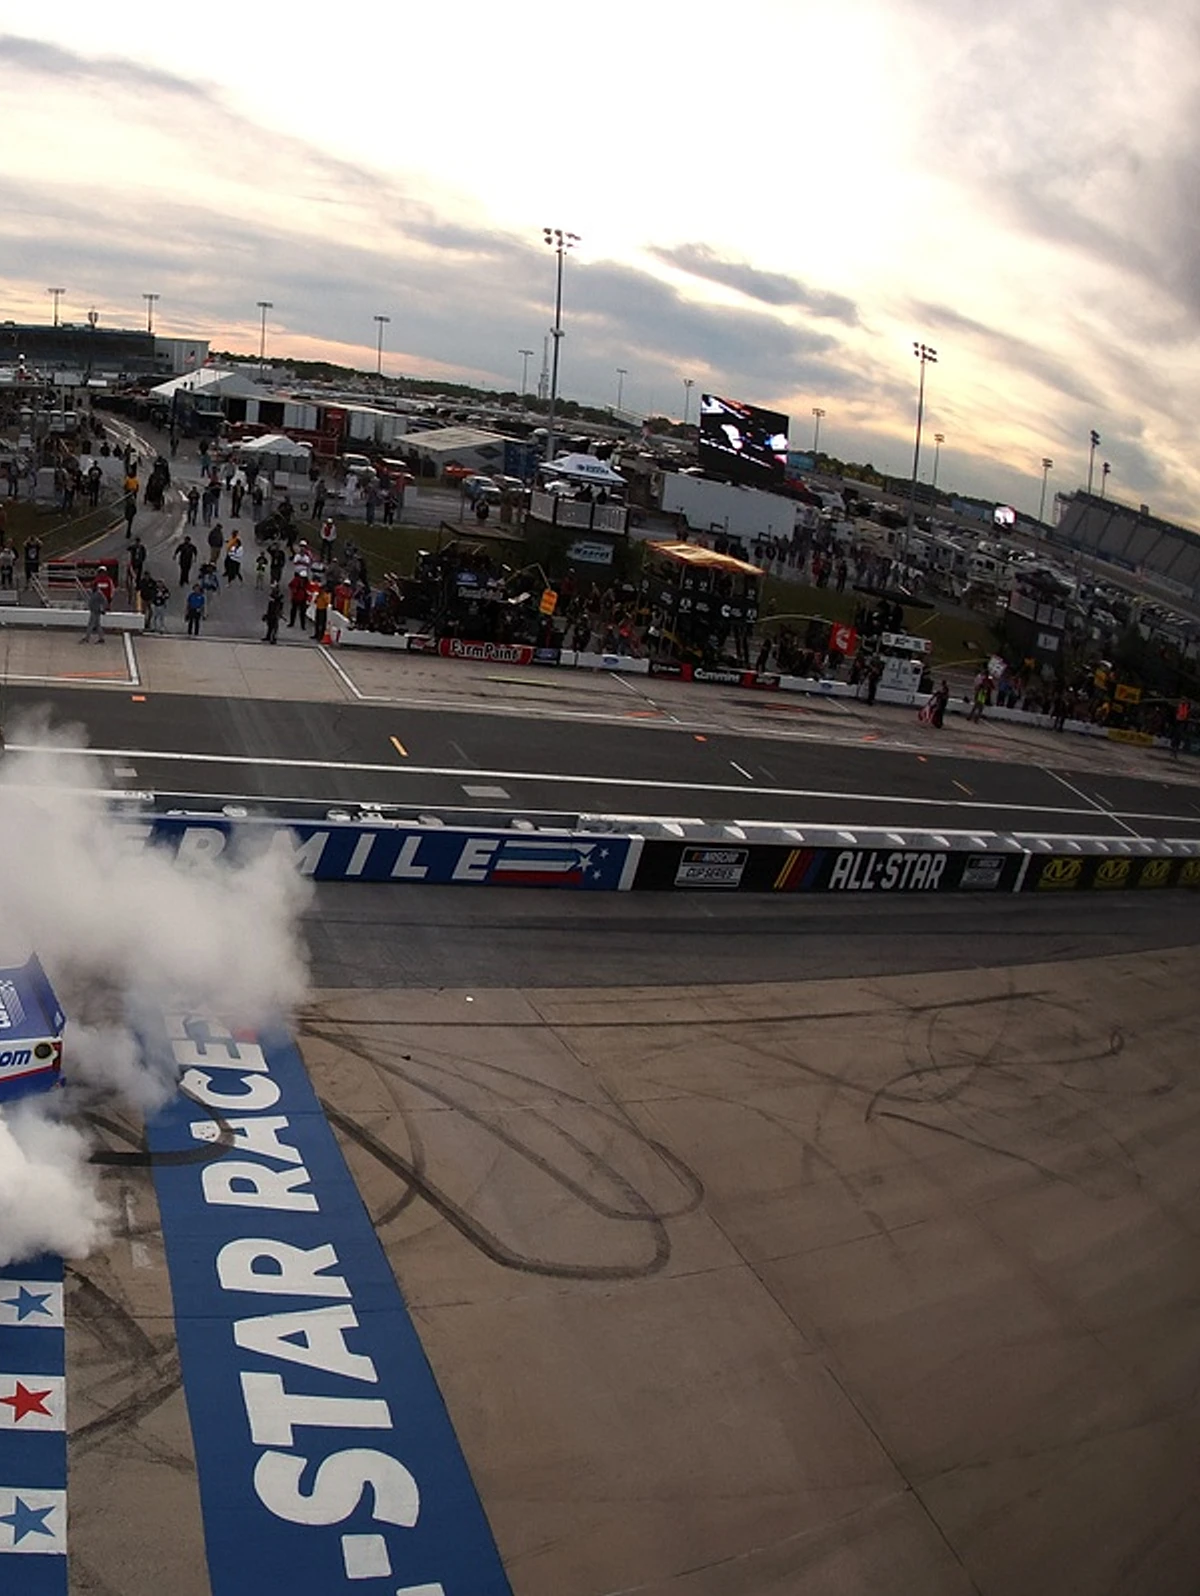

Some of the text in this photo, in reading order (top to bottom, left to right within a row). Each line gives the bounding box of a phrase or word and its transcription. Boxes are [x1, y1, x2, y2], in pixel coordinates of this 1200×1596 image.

[449, 639, 521, 660] FarmPaint
[694, 668, 740, 683] Cummins
[262, 829, 500, 882] MILE
[165, 1014, 319, 1212] RACE
